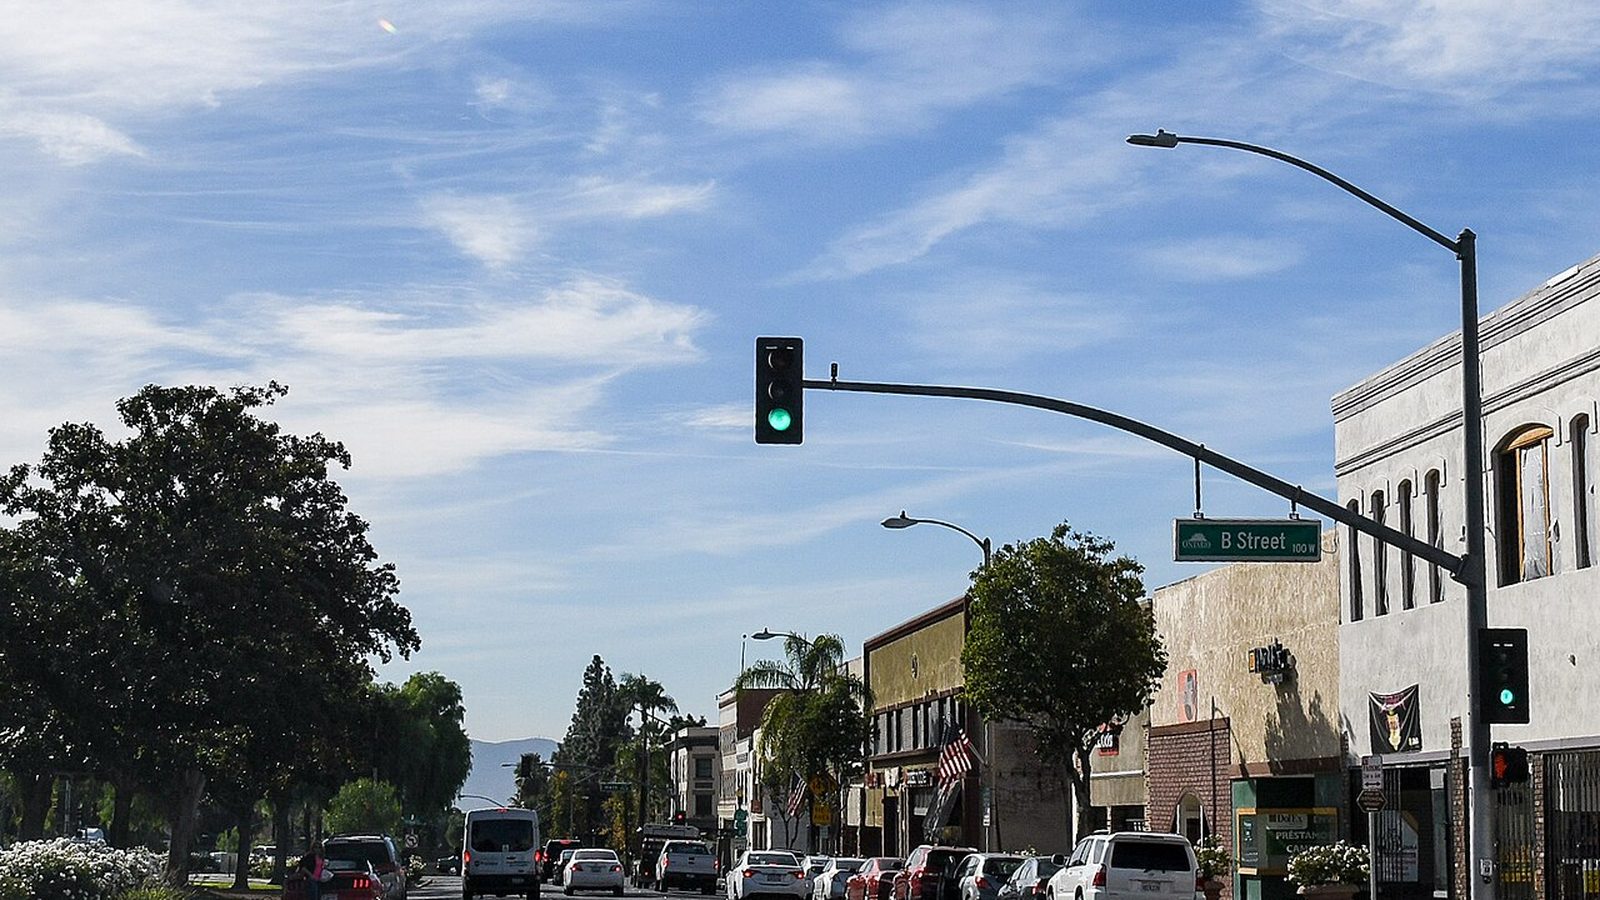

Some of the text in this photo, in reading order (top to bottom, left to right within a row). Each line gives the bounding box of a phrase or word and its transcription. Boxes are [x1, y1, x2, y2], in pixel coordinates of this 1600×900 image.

[1221, 531, 1286, 550] B Street
[1292, 543, 1316, 554] 100 W
